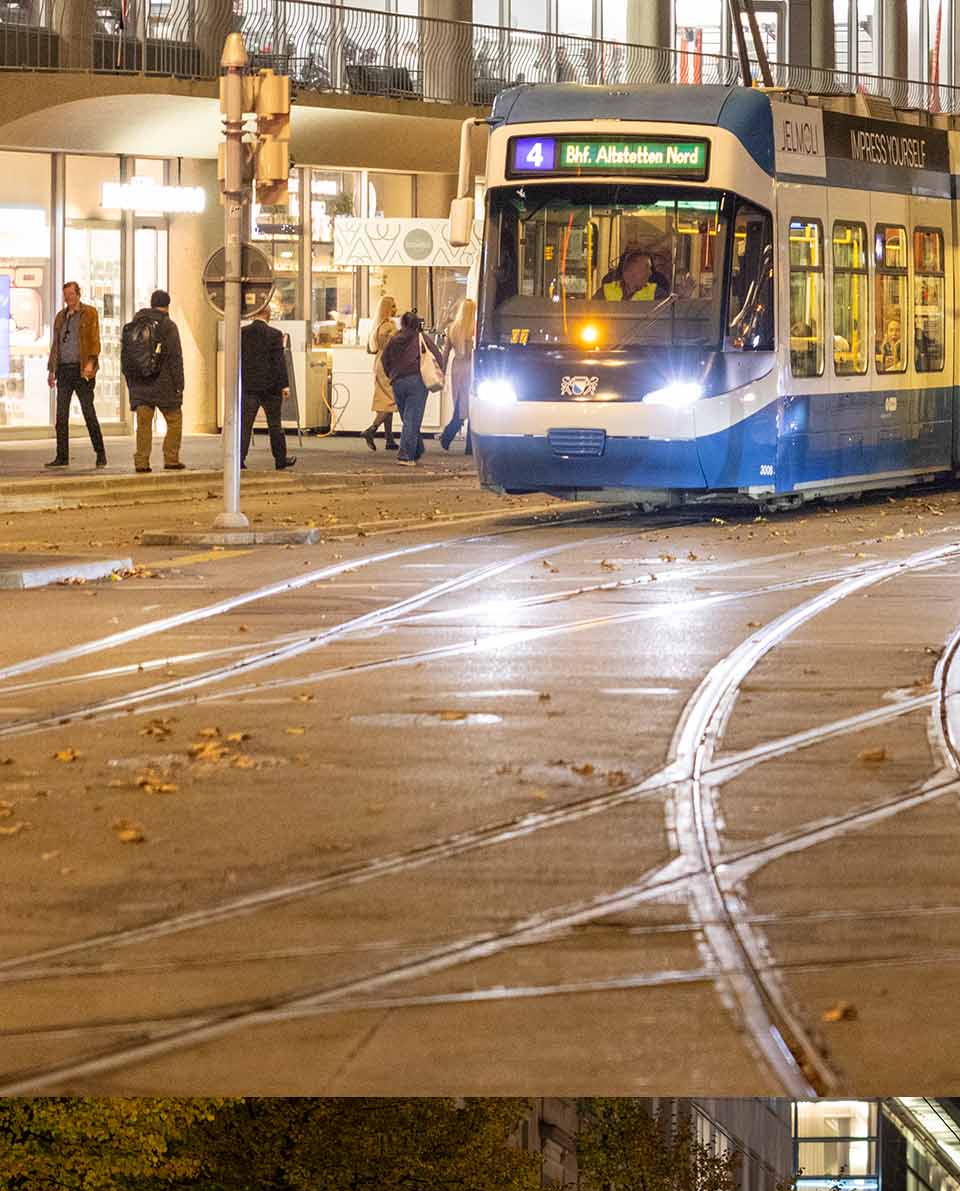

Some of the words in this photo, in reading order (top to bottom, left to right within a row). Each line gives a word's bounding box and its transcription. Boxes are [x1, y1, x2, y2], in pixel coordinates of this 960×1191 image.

[526, 142, 543, 167] 4
[566, 145, 592, 164] Bhf.
[595, 145, 662, 164] Altstetten
[666, 145, 699, 164] Nord
[851, 129, 887, 164] IMPRESS
[887, 135, 927, 168] YOURSELF
